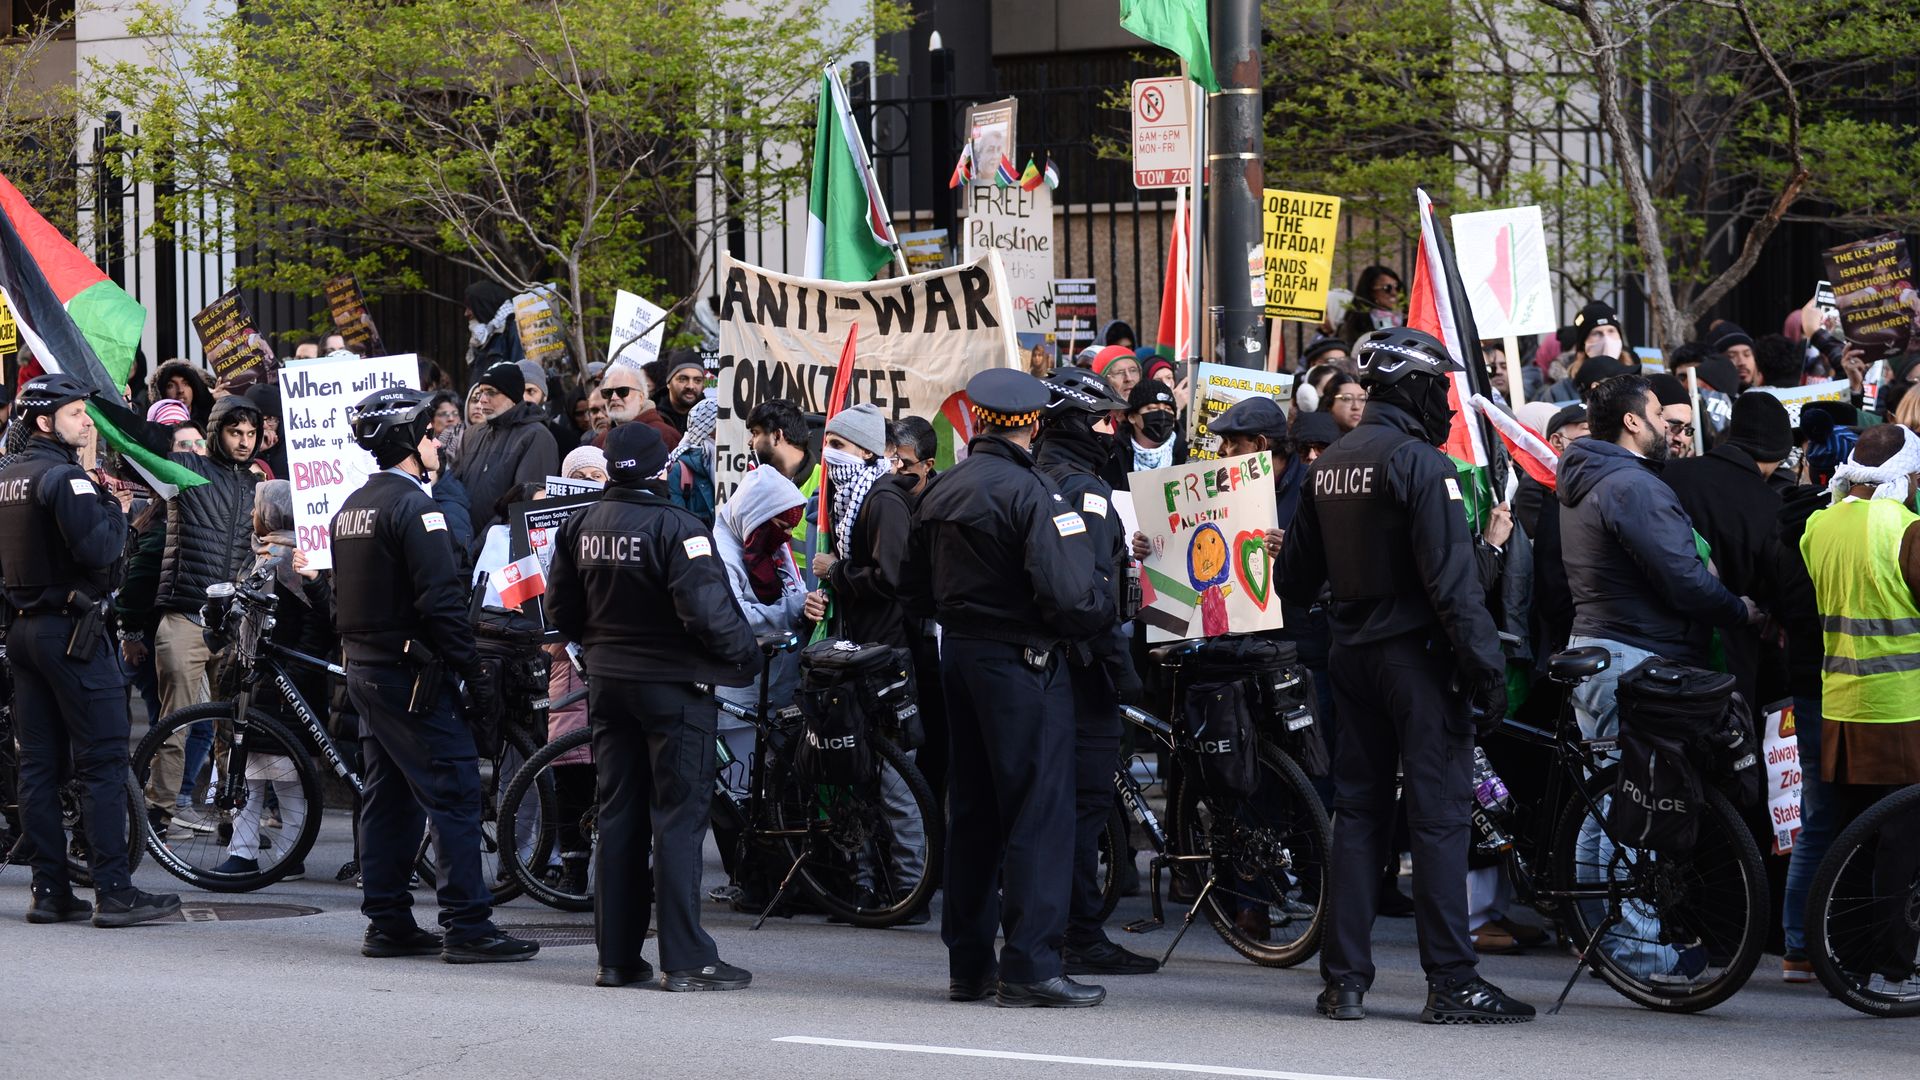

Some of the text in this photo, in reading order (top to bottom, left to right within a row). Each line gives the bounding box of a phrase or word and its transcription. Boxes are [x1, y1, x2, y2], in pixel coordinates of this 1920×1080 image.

[1140, 171, 1165, 184] TOW
[971, 219, 1049, 252] Palestine
[1276, 215, 1304, 234] THE
[1833, 240, 1897, 264] THE U.S. AND
[1012, 263, 1035, 279] this
[1840, 256, 1897, 278] ISRAEL ARE
[1273, 274, 1318, 292] RAFAH
[1833, 267, 1912, 295] INTENTIONALLY
[719, 265, 999, 336] ANTI-WAR
[1026, 281, 1054, 328] NOW
[1851, 286, 1902, 306] STARVING
[636, 306, 651, 324] PEACE
[1847, 299, 1914, 322] PALESTINIAN
[205, 309, 240, 337] ISRAEL ARE
[204, 316, 252, 353] INTENTIONALLY
[27, 383, 48, 391] POLICE
[281, 370, 407, 399] When will the
[1082, 376, 1105, 392] POLICE
[1209, 375, 1281, 395] ISRAEL HAS
[380, 392, 405, 401] POLICE
[322, 407, 337, 428] of
[291, 432, 326, 450] wake
[331, 437, 343, 450] up
[293, 458, 344, 491] BIRDS
[614, 459, 637, 469] CPD
[545, 483, 567, 496] FREE
[1315, 466, 1374, 496] POLICE
[306, 493, 329, 515] not
[336, 508, 376, 537] POLICE
[581, 535, 642, 562] POLICE
[275, 675, 339, 766] CHICAGO POLICE
[1622, 779, 1687, 813] POLICE
